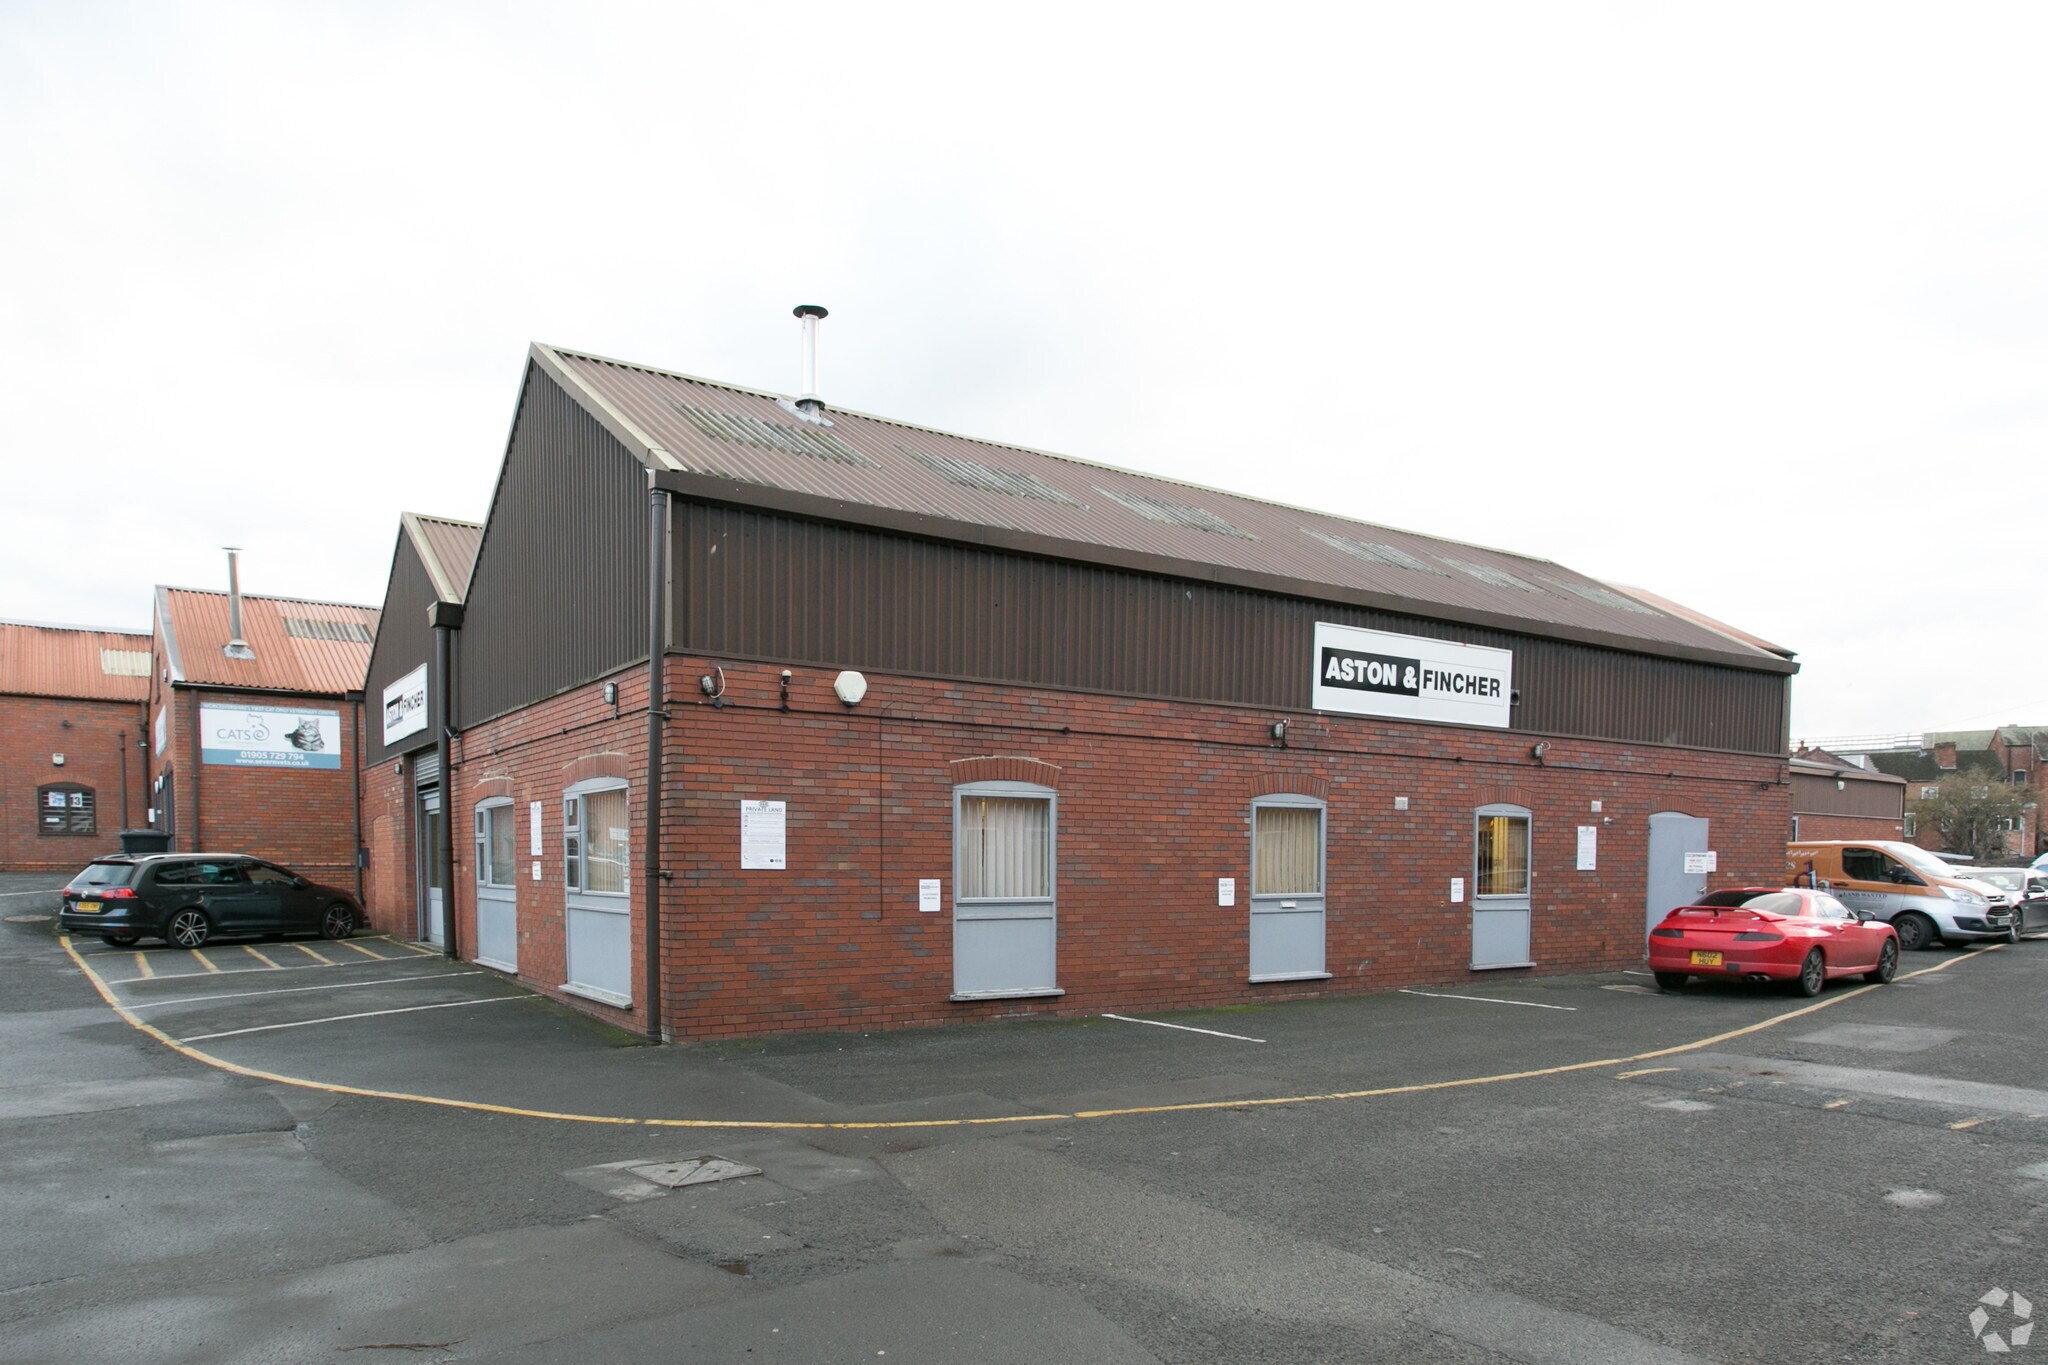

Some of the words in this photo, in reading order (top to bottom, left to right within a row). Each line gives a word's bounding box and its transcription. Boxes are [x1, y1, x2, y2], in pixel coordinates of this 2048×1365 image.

[1325, 656, 1398, 687] ASTON
[1402, 665, 1418, 689] &
[1422, 669, 1501, 698] FINCHER
[404, 690, 424, 713] FINCHER
[216, 728, 251, 741] CATS
[240, 751, 268, 759] 01905
[270, 752, 287, 760] 729
[288, 753, 305, 761] 794
